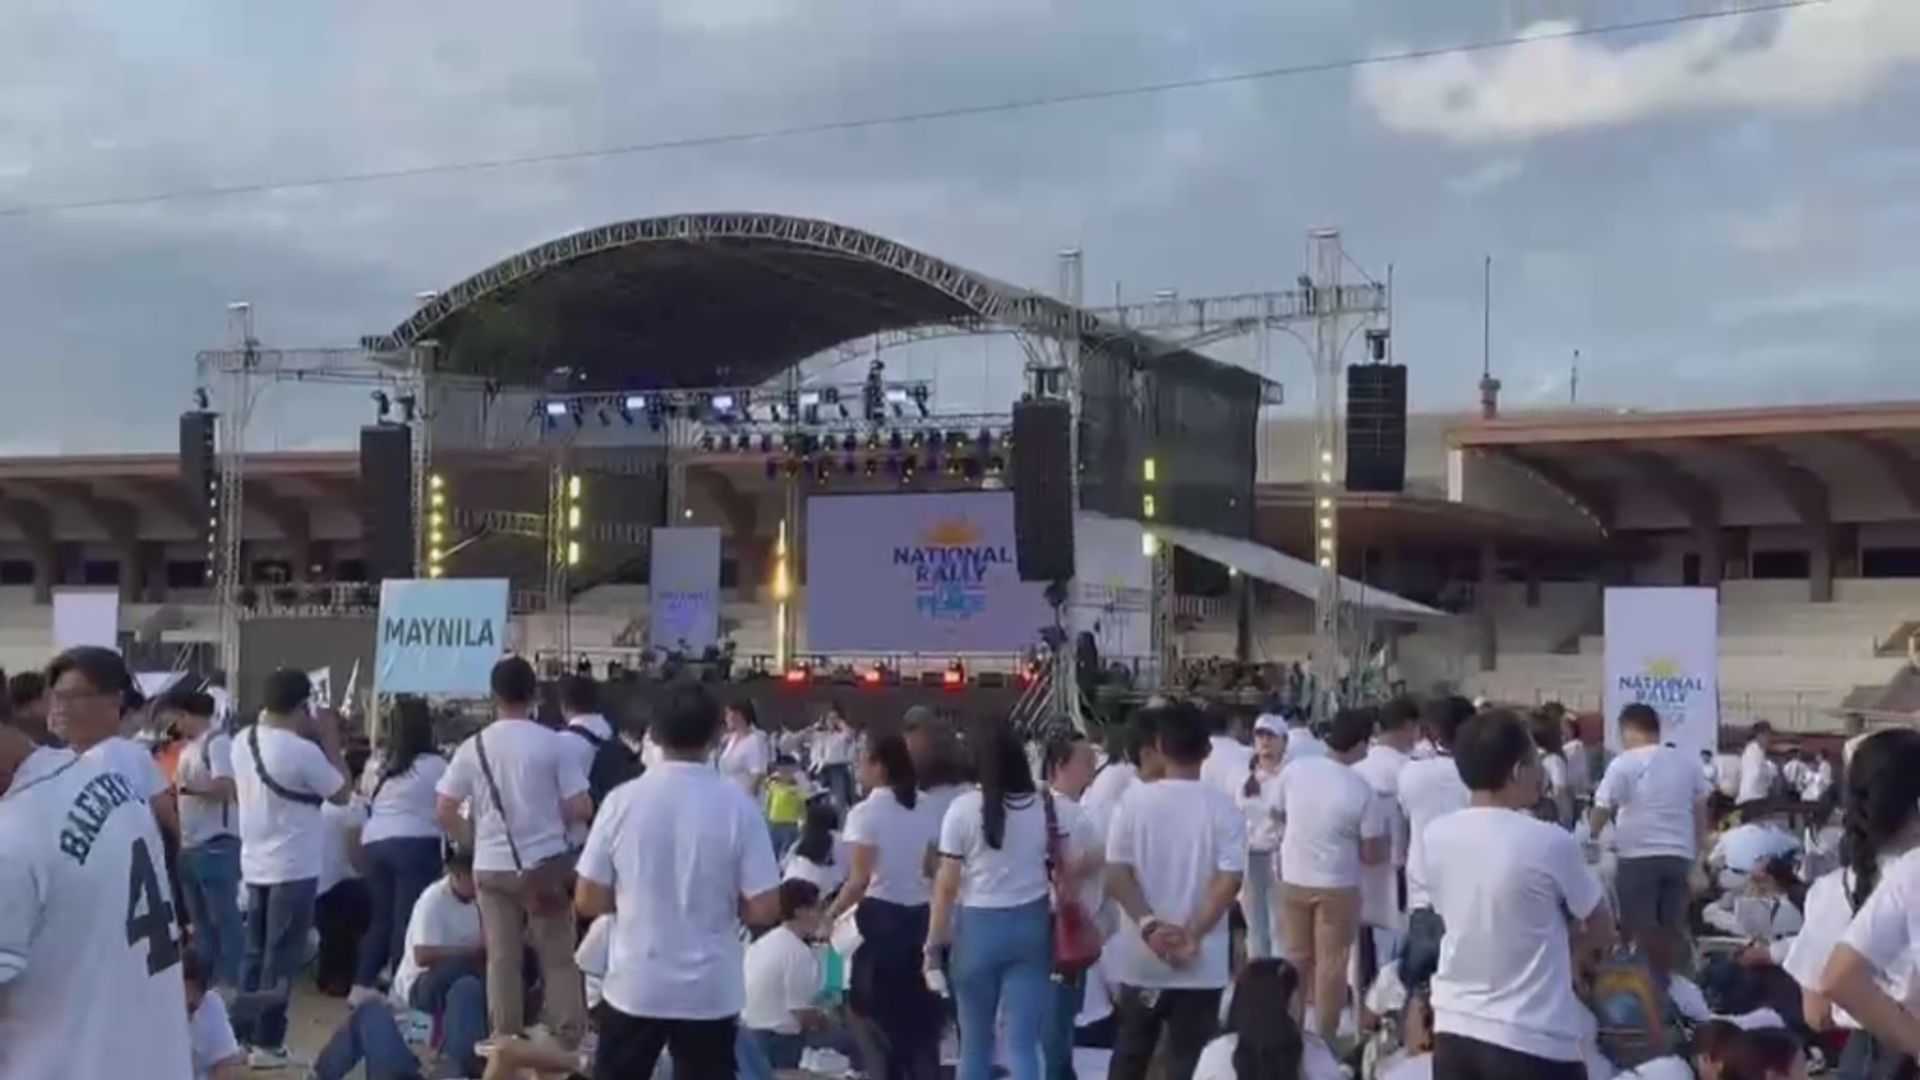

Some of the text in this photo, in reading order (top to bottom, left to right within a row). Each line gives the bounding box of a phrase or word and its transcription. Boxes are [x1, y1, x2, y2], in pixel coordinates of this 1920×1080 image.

[893, 545, 1013, 565] NATIONAL
[916, 563, 987, 582] RALLY
[384, 616, 495, 647] MAYNILA
